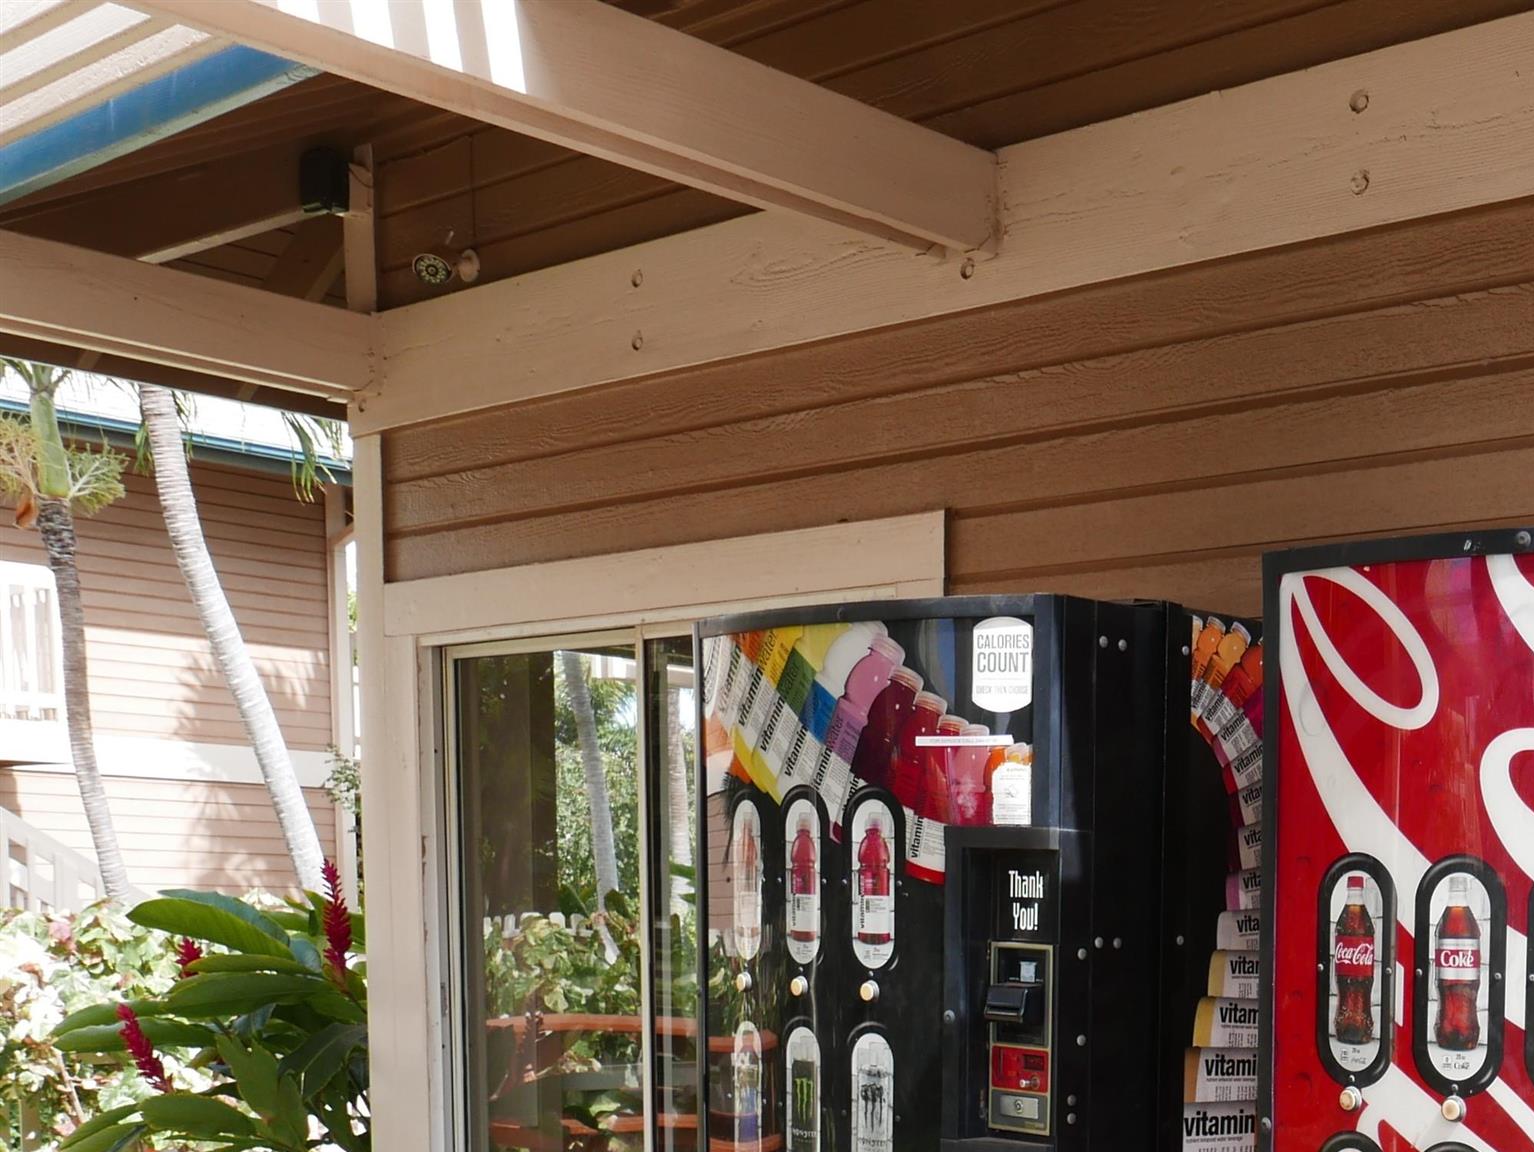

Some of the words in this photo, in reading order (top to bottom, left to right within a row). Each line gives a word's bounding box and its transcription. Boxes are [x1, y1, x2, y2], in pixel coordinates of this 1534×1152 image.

[977, 634, 1029, 649] CALORIES
[977, 652, 1029, 673] COUNT
[1008, 870, 1044, 899] Thank
[1013, 902, 1039, 931] You!
[1335, 942, 1374, 966] Coca-Cola
[1441, 949, 1474, 967] Coke
[1184, 1109, 1255, 1136] vitamin
